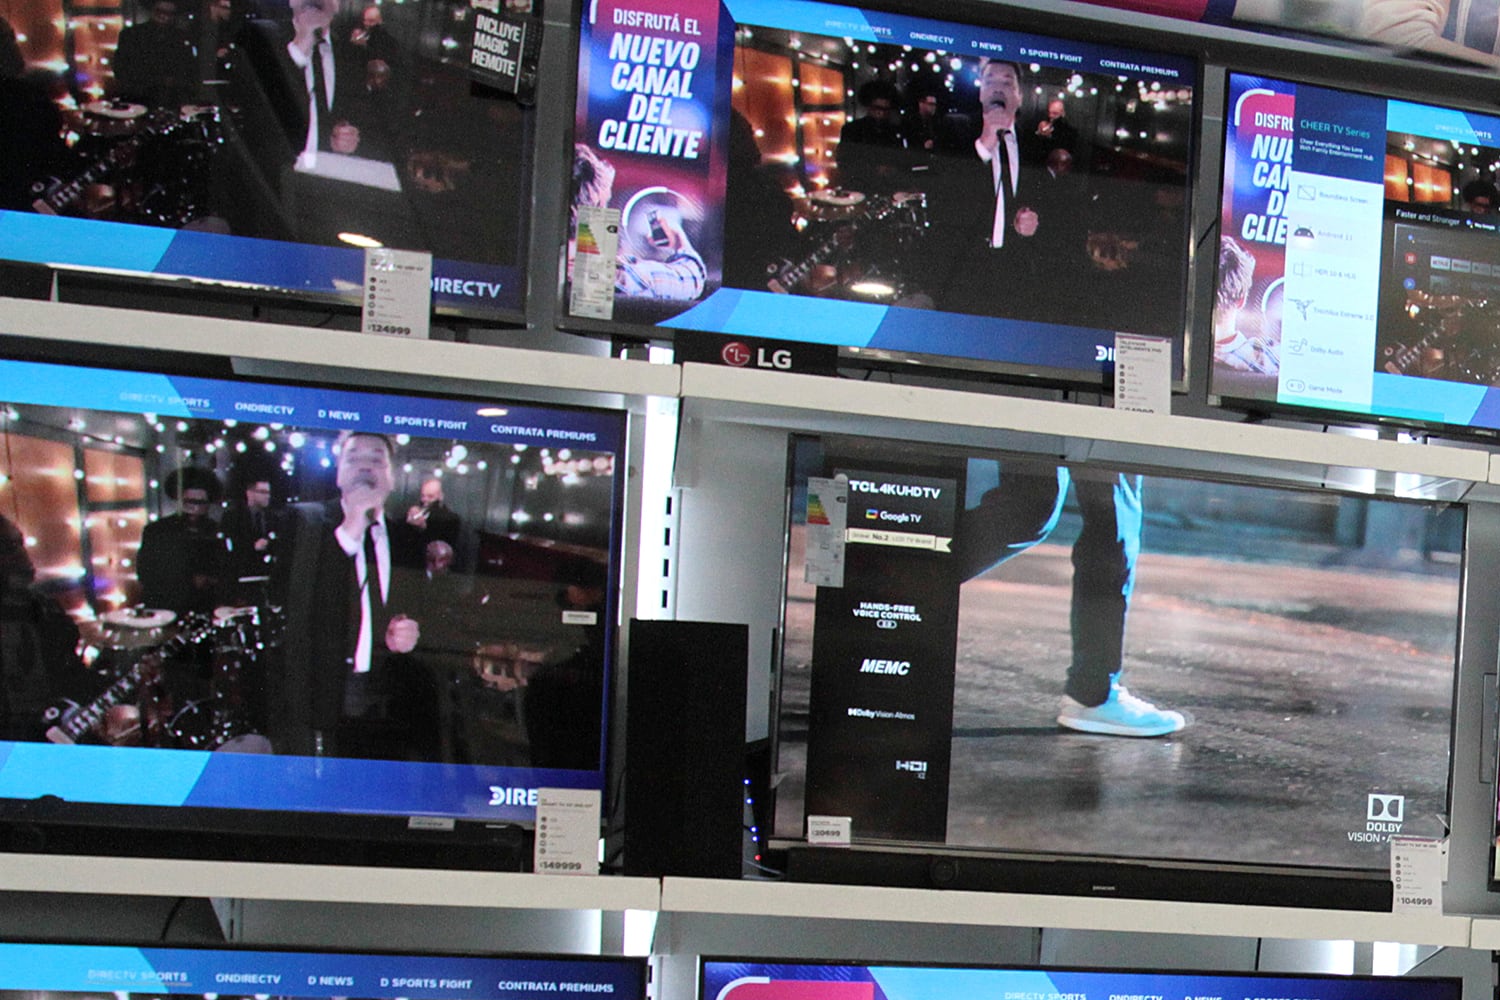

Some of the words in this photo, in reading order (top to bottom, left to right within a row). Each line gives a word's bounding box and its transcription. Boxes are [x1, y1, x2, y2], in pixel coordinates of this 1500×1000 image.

[476, 14, 523, 42] INCLUYE
[613, 7, 681, 33] DISFRUTÁ
[684, 18, 702, 35] EL
[474, 31, 509, 56] MAGIC
[609, 32, 700, 70] NUEVO
[979, 41, 1003, 52] NEWS
[471, 48, 517, 78] REMOTE
[1028, 48, 1059, 60] SPORTS
[1060, 53, 1083, 64] FIGHT
[1100, 59, 1139, 72] CONTRATA
[1141, 64, 1179, 77] PREMIUMS
[610, 61, 693, 99] CANAL
[627, 93, 673, 126] DEL
[1254, 111, 1295, 132] DISFRU
[1300, 119, 1331, 133] CHEER
[1332, 124, 1344, 134] TV
[1345, 126, 1371, 139] Series
[598, 119, 703, 159] CLIENTE
[1396, 208, 1417, 220] Faster
[1418, 212, 1431, 222] and
[1432, 214, 1461, 228] Stronger
[1241, 213, 1288, 245] CLIE
[430, 276, 502, 298] IRECTV
[758, 347, 792, 369] LG
[234, 402, 295, 416] ONDIRECTV
[318, 408, 326, 418] D
[328, 410, 361, 422] NEWS
[384, 414, 392, 424] D
[394, 415, 435, 429] SPORTS
[437, 419, 468, 431] FIGHT
[491, 423, 545, 438] CONTRATA
[546, 428, 598, 443] PREMIUMS
[849, 479, 880, 493] TCL
[896, 485, 921, 498] UHD
[922, 486, 941, 500] TV
[879, 510, 910, 524] Google
[910, 514, 922, 523] TV
[852, 608, 880, 619] VOICE
[880, 610, 922, 622] CONTROL
[859, 602, 916, 613] HANDS-FREE
[859, 658, 911, 676] MEMC
[1347, 831, 1380, 842] VISION
[1366, 821, 1402, 833] DOLBY
[215, 972, 282, 985] ONDIRECTV
[308, 976, 316, 986] D
[319, 976, 354, 987] NEWS
[380, 977, 389, 988] D
[391, 978, 437, 990] SPORTS
[439, 980, 473, 991] FIGHT
[498, 980, 557, 993] CONTRATA
[558, 982, 615, 994] PREMIUMS
